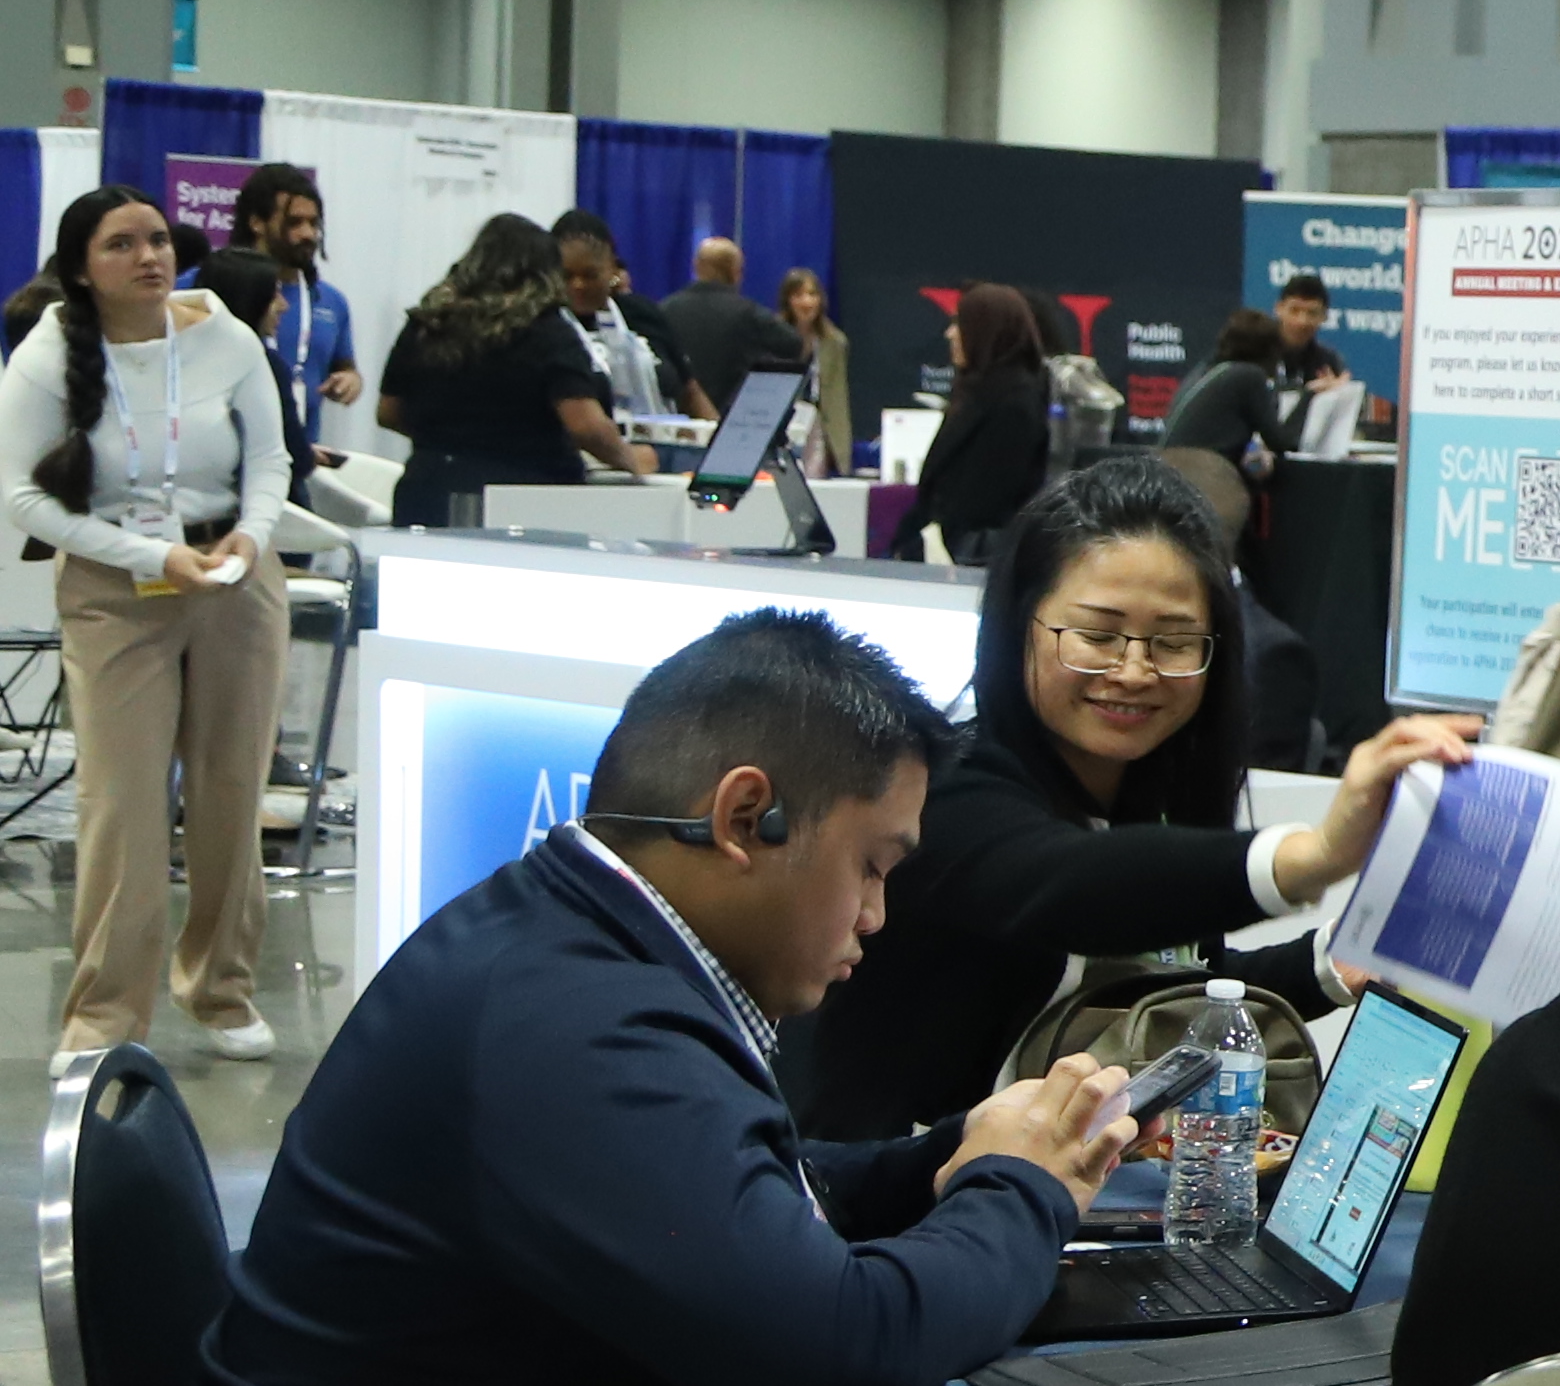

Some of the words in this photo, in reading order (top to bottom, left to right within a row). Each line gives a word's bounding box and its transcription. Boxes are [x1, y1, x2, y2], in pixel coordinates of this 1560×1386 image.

[1452, 224, 1516, 261] APHA
[1127, 321, 1183, 344] Public
[1433, 328, 1451, 345] you
[1453, 326, 1493, 346] enjoyed
[1495, 329, 1518, 346] your
[1127, 342, 1187, 362] Health
[1429, 356, 1474, 375] program,
[1476, 354, 1508, 374] please
[1511, 356, 1524, 372] let
[1526, 359, 1539, 373] us
[1433, 382, 1455, 398] here
[1470, 384, 1515, 403] complete
[1528, 386, 1553, 402] short
[1439, 444, 1509, 485] SCAN
[1434, 485, 1507, 566] ME
